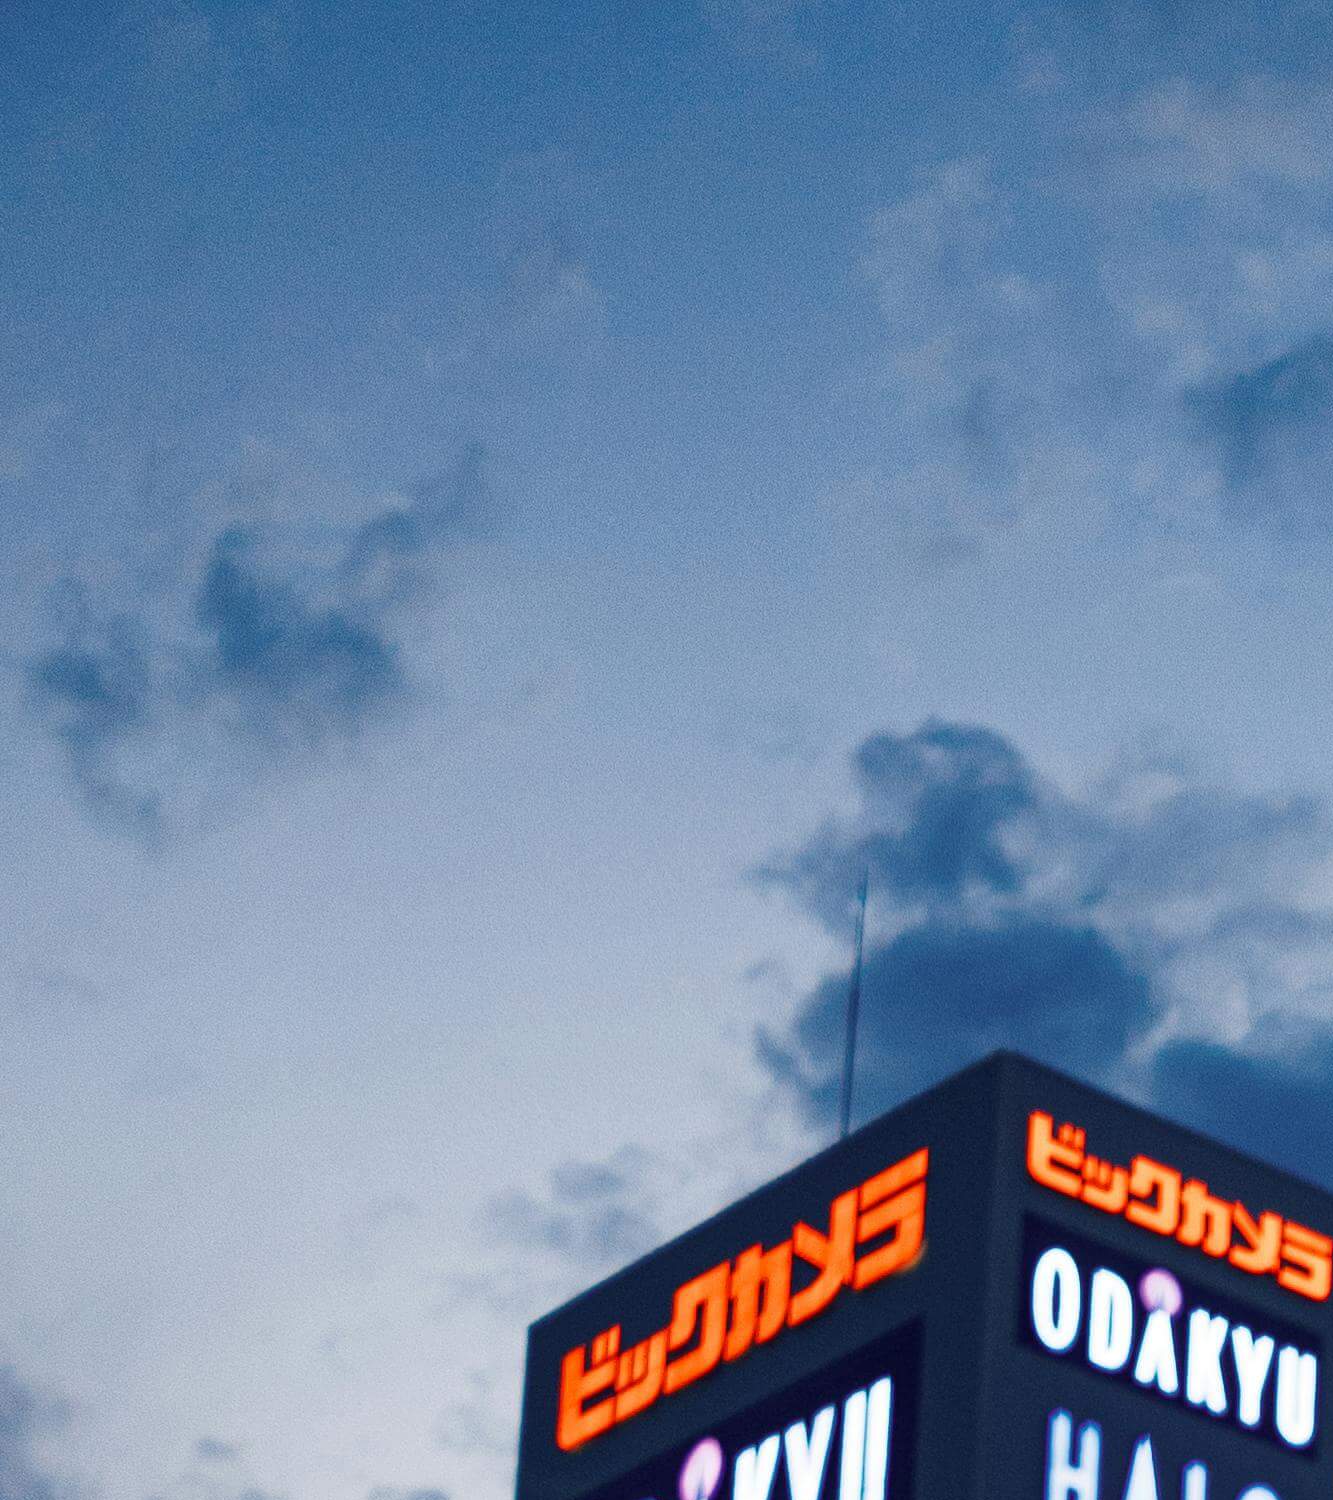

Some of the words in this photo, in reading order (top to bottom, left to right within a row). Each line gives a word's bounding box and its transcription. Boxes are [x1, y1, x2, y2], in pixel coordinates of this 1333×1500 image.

[555, 1147, 930, 1452] ビックカメラ
[1027, 1109, 1333, 1301] ビックカメラ
[1031, 1247, 1319, 1448] ODAKYU
